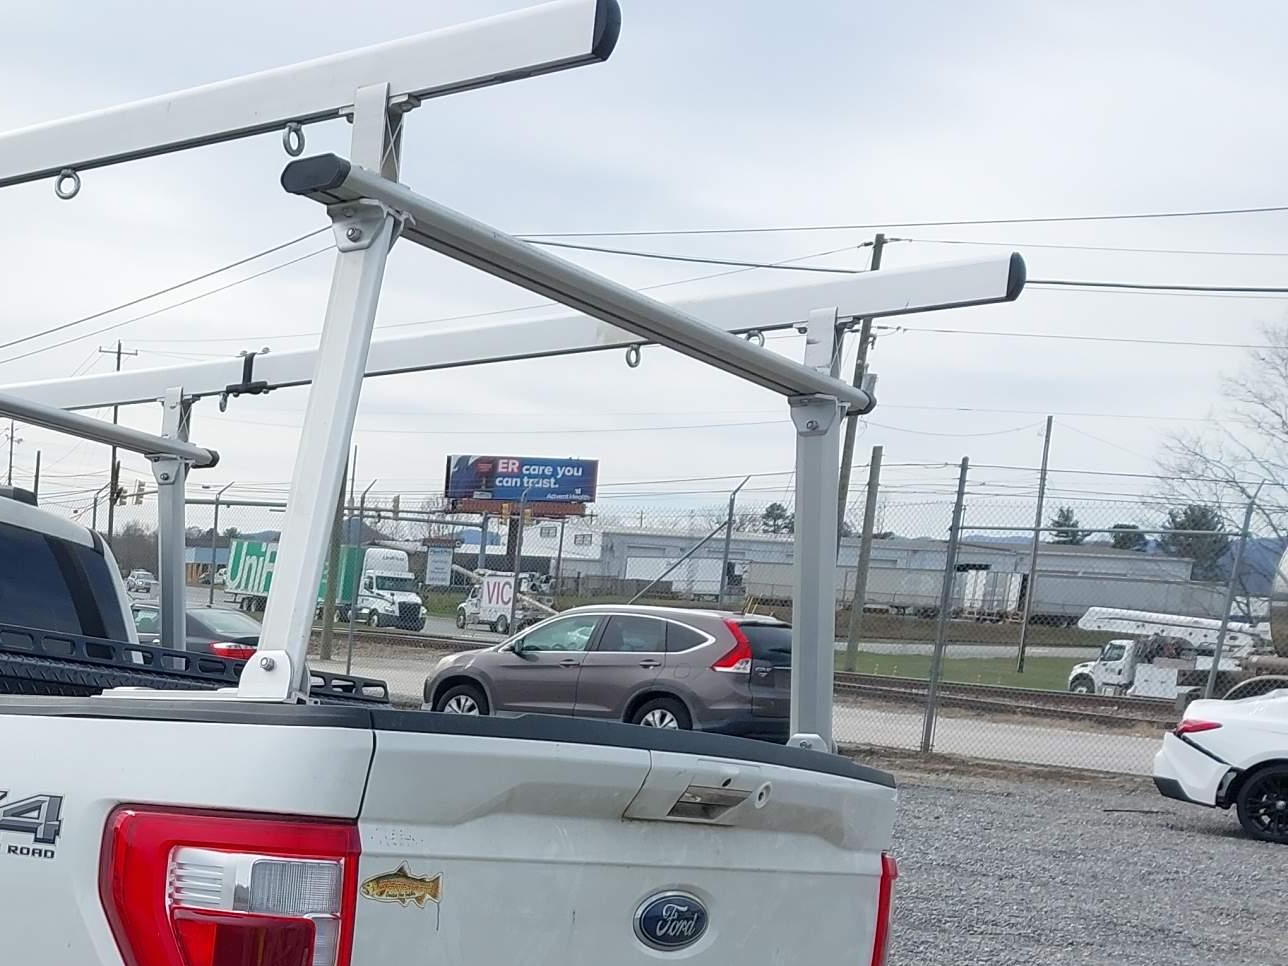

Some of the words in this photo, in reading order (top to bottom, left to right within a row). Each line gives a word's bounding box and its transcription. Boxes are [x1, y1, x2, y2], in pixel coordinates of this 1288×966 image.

[497, 459, 519, 473] ER
[522, 464, 553, 476] care
[557, 466, 583, 479] you
[495, 476, 521, 487] can
[522, 476, 559, 489] trust.
[8, 844, 56, 860] ROAD
[655, 904, 698, 937] Ford
